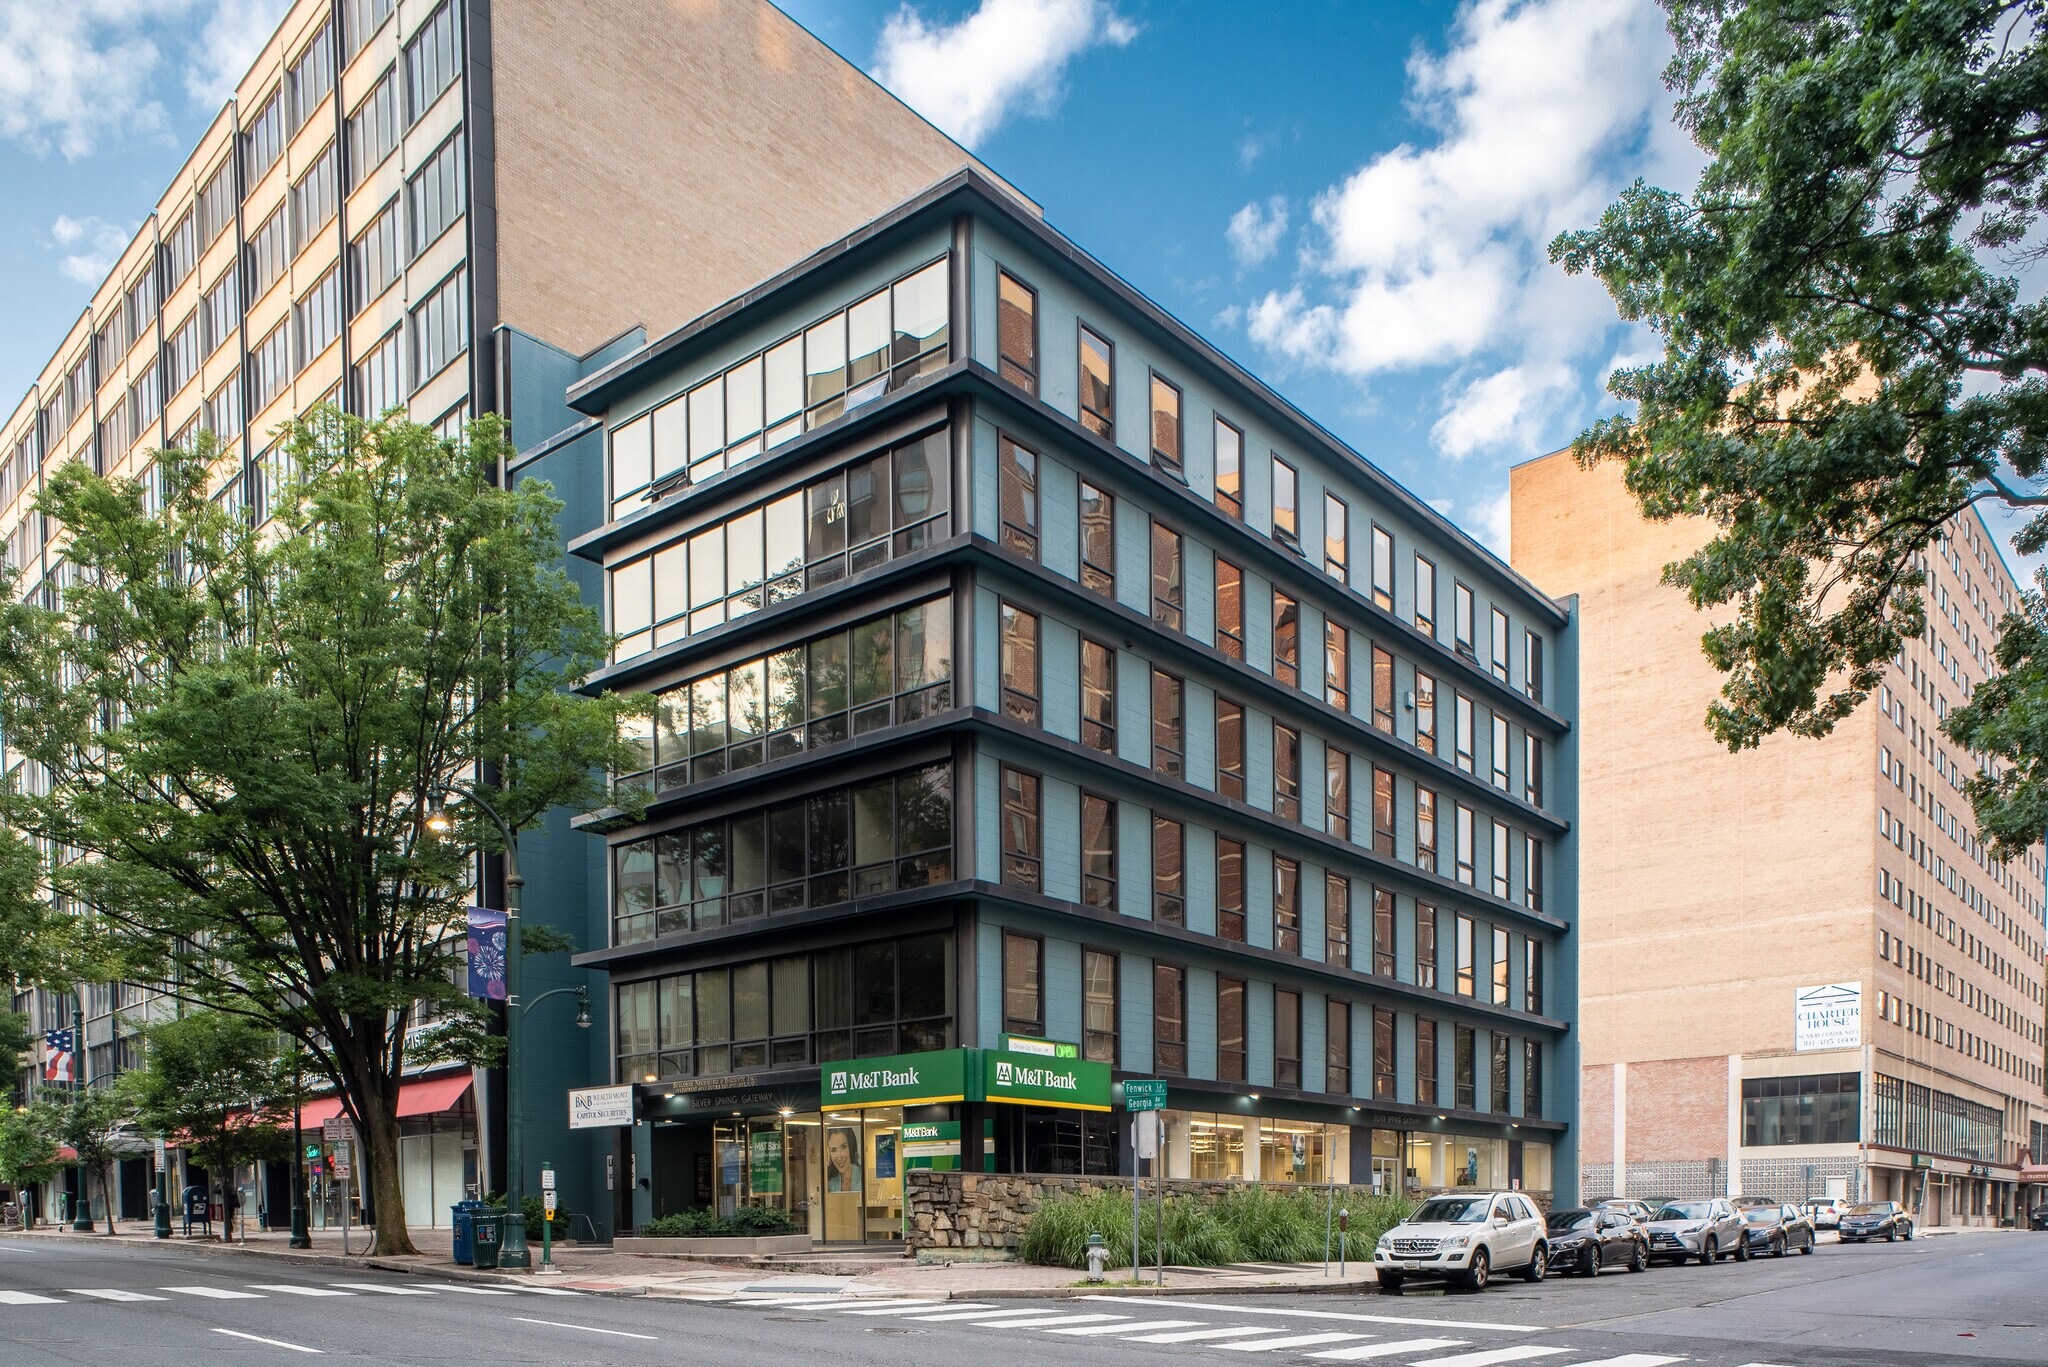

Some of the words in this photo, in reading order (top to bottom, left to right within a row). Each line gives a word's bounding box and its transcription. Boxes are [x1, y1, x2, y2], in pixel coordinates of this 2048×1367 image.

[1798, 1008, 1859, 1020] CHARTER
[1808, 1018, 1850, 1029] HOUSE
[1056, 1044, 1077, 1058] OPEN
[850, 1070, 881, 1090] M&T
[882, 1067, 919, 1087] Bank
[1015, 1066, 1043, 1086] M&T
[1044, 1070, 1077, 1090] Bank
[1126, 1084, 1152, 1093] Fenwick
[575, 1093, 593, 1110] BNB
[593, 1093, 613, 1101] WEALTH
[692, 1099, 712, 1108] SILVER
[715, 1095, 738, 1106] SPRING
[742, 1092, 773, 1104] GATEWAY
[1128, 1098, 1152, 1110] Georgia
[577, 1111, 597, 1119] CAPITOL
[597, 1109, 627, 1119] SECURITIES
[904, 1127, 921, 1138] M&T
[922, 1126, 938, 1137] Bank
[754, 1142, 767, 1151] M&T
[768, 1140, 782, 1150] Bank
